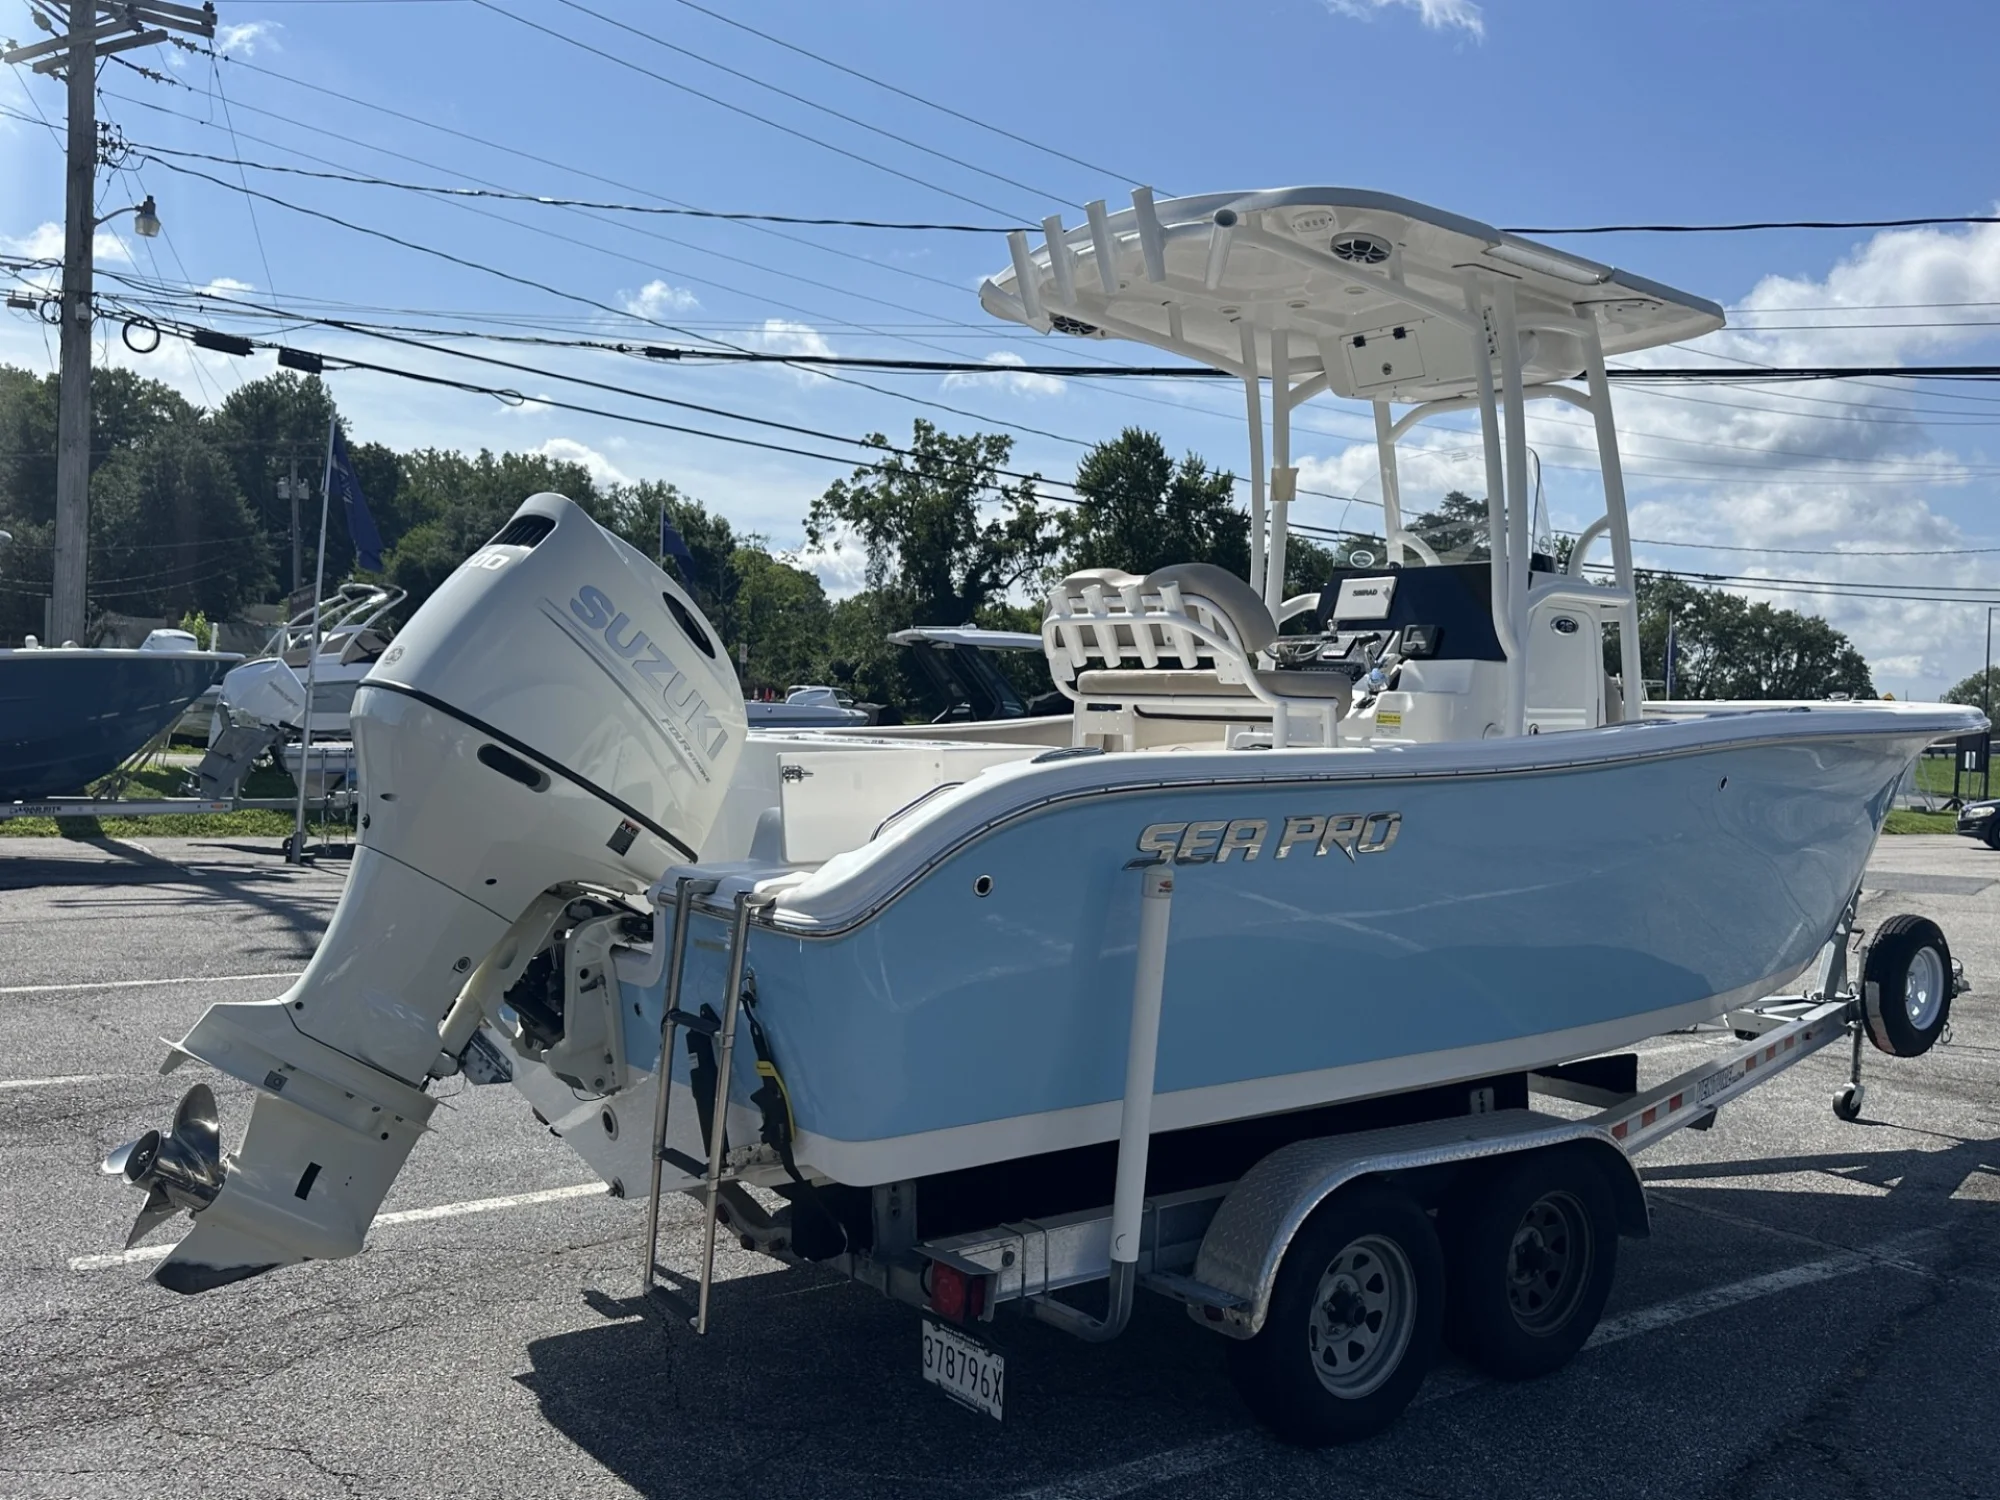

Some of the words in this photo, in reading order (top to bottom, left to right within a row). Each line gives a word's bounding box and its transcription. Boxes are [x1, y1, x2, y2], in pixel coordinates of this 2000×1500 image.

[1352, 588, 1378, 597] SIMRAD
[569, 584, 729, 762] SUZUKI
[660, 717, 692, 752] FOUR
[1122, 818, 1268, 871] SEA
[1274, 811, 1402, 864] PRO
[924, 1335, 1002, 1406] 378796X
